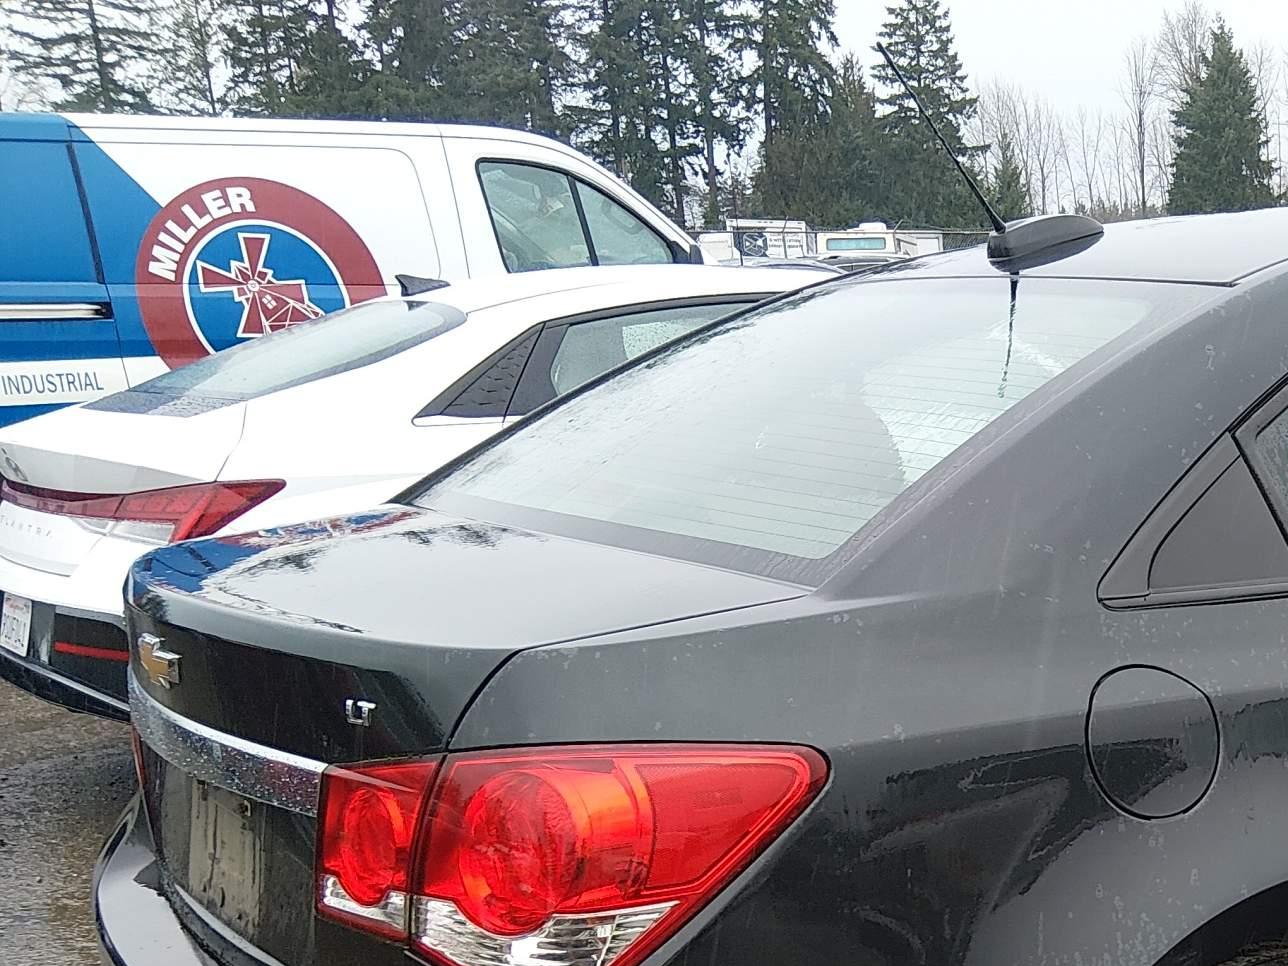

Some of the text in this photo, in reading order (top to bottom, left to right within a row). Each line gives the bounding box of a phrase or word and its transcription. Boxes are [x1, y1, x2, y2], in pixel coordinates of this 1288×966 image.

[148, 186, 256, 282] MILLER
[1, 371, 104, 395] INDUSTRIAL
[345, 699, 377, 727] LT
